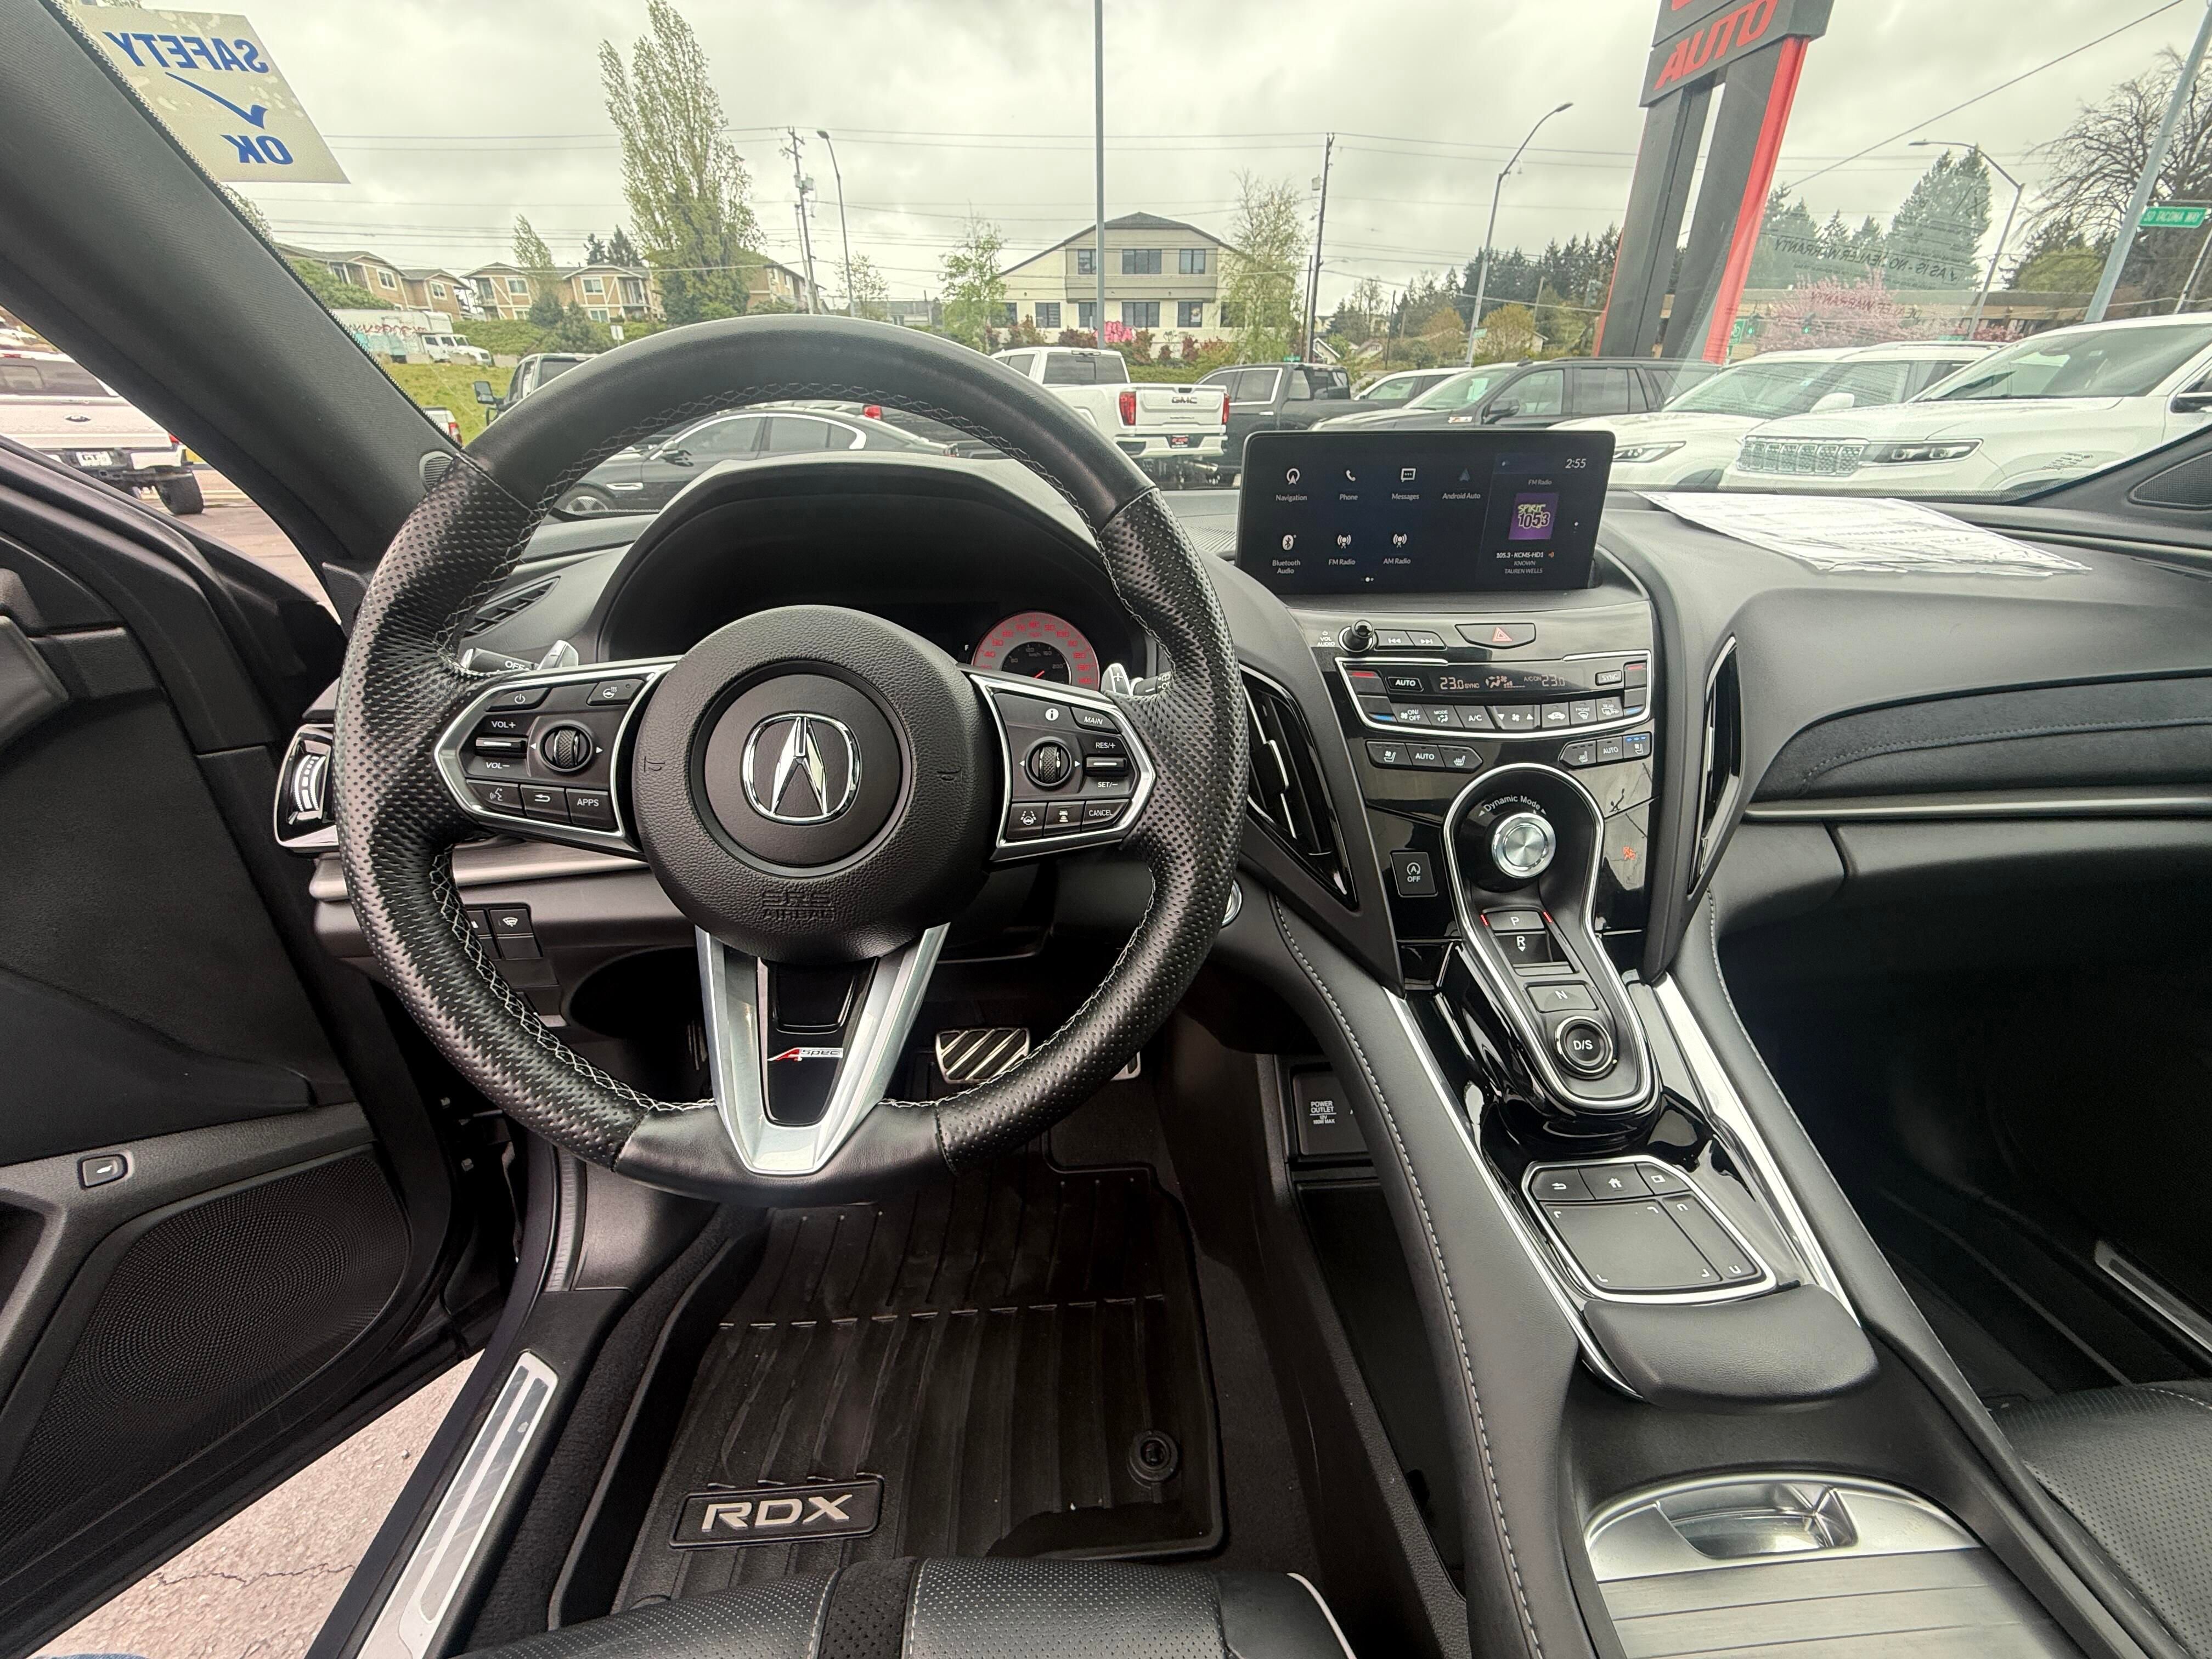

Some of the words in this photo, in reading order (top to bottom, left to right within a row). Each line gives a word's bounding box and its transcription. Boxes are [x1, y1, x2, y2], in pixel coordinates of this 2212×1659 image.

[1654, 0, 1777, 91] AUTO
[1565, 459, 1587, 469] 2:55
[1517, 504, 1546, 514] SPIRIT
[1440, 677, 1464, 690] 23.0
[1084, 716, 1103, 725] MAIN
[577, 798, 600, 806] APPS
[1483, 794, 1518, 812] Dynamic
[1520, 795, 1541, 810] Mode
[1510, 916, 1520, 926] P
[1516, 936, 1526, 947] R
[1555, 990, 1568, 1000] N
[1573, 1040, 1593, 1050] D/S
[701, 1494, 853, 1532] RDX
